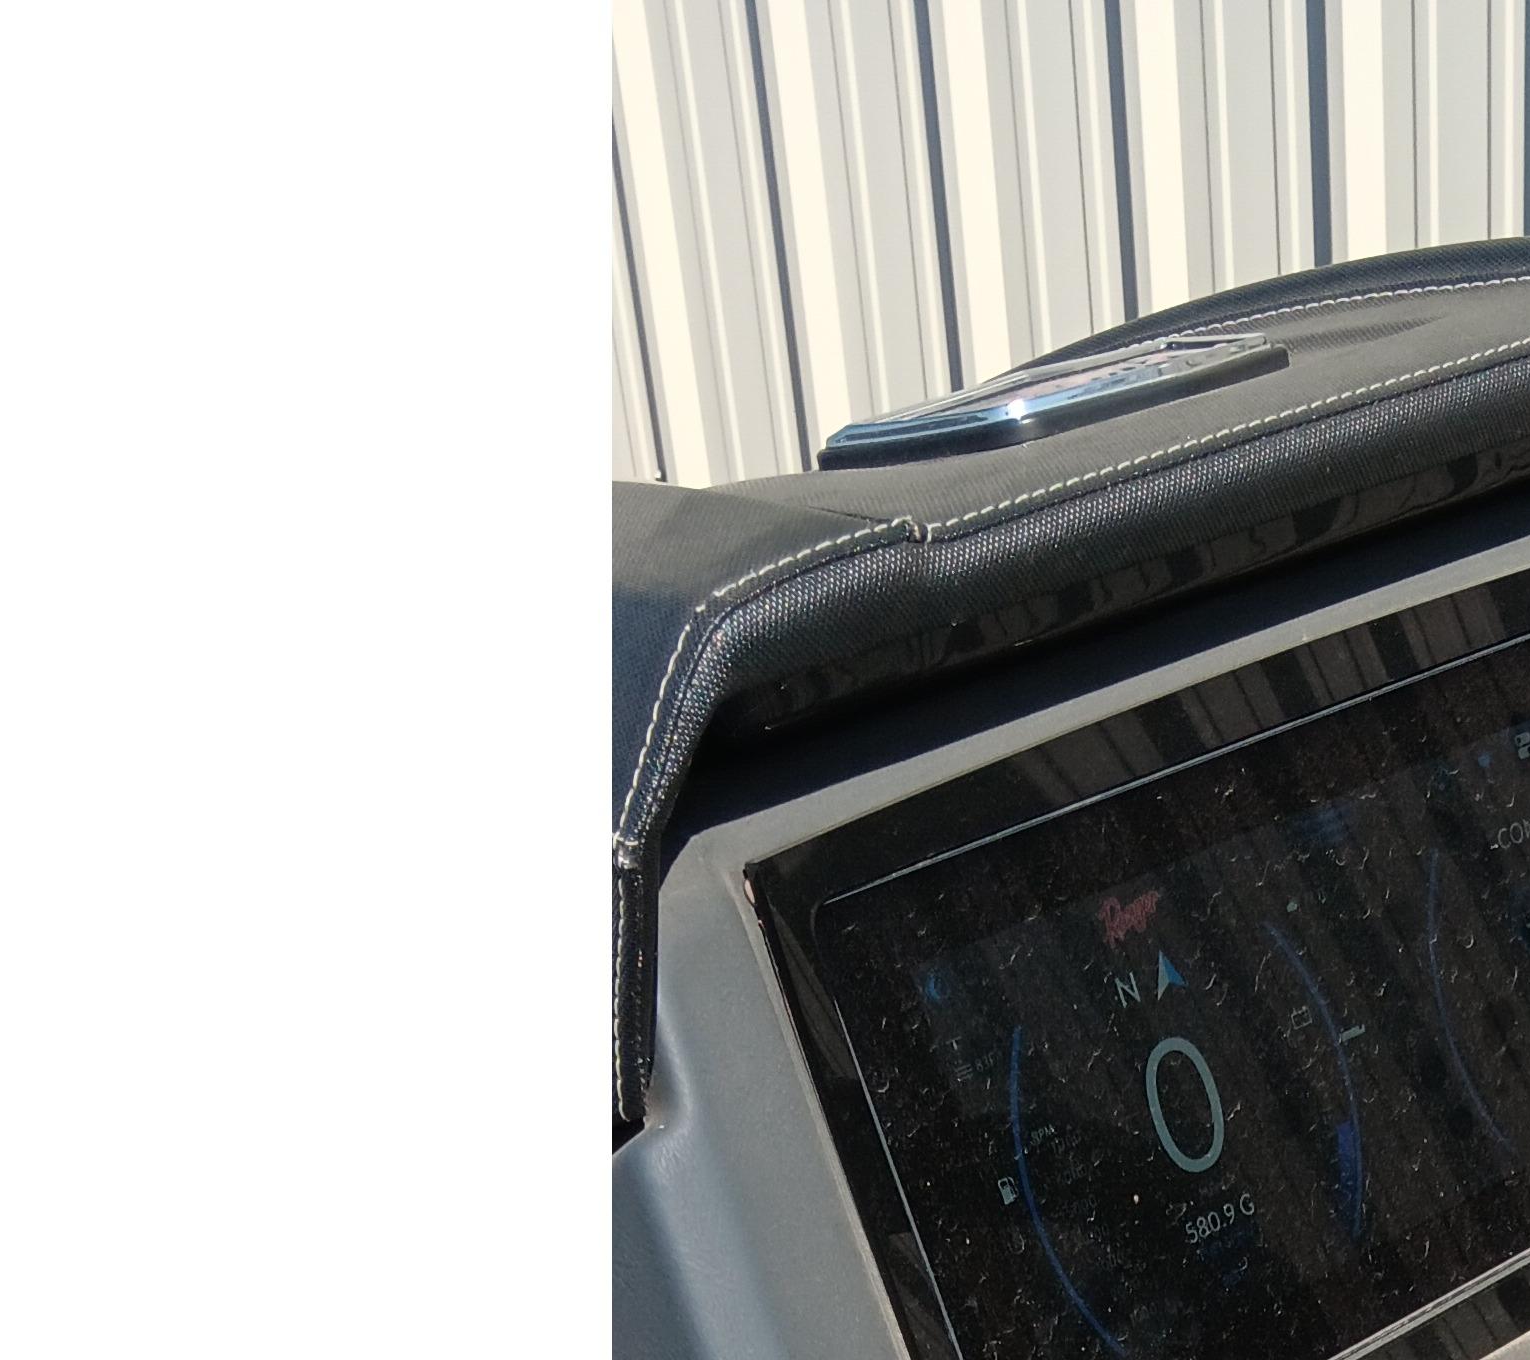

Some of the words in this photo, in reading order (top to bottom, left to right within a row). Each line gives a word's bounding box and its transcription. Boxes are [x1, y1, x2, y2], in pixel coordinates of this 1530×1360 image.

[1113, 972, 1141, 1009] N
[1144, 1036, 1226, 1175] 0
[1183, 1203, 1236, 1244] 580.9
